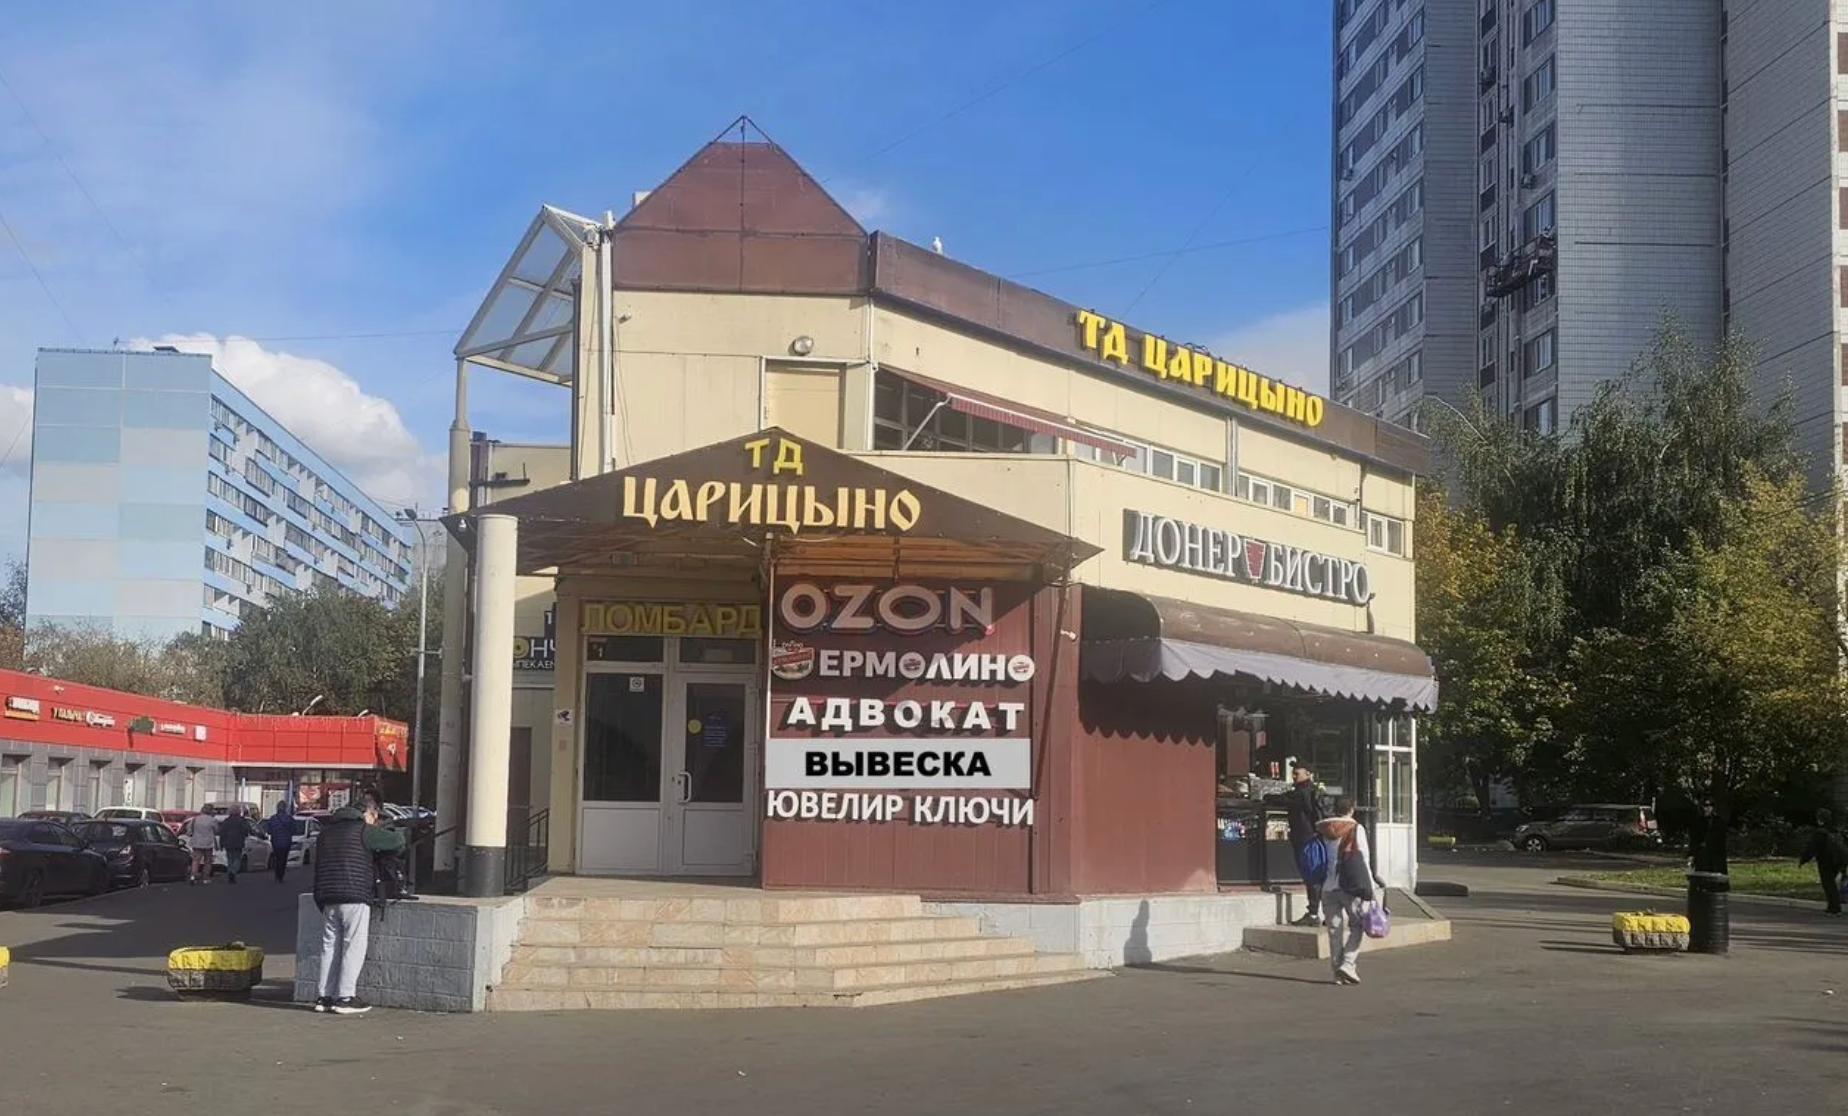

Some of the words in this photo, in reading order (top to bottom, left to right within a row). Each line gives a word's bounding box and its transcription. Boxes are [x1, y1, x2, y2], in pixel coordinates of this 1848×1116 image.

[1079, 310, 1129, 365] ТД
[1144, 334, 1324, 427] ЦАРИЦЫНО
[744, 437, 804, 476] ТД
[622, 475, 922, 536] ЦАРИЦЫНО
[1130, 510, 1243, 577] ДОНЕР
[1264, 543, 1371, 604] БИСТРО
[581, 603, 763, 637] ЛОМБАРД
[780, 583, 996, 637] OZON
[819, 649, 1035, 681] ЕРМОЛИНО
[787, 697, 1025, 731] АДВОКАТ
[767, 790, 903, 821] ЮВЕЛИР
[914, 795, 1034, 825] КЛЮЧИ
